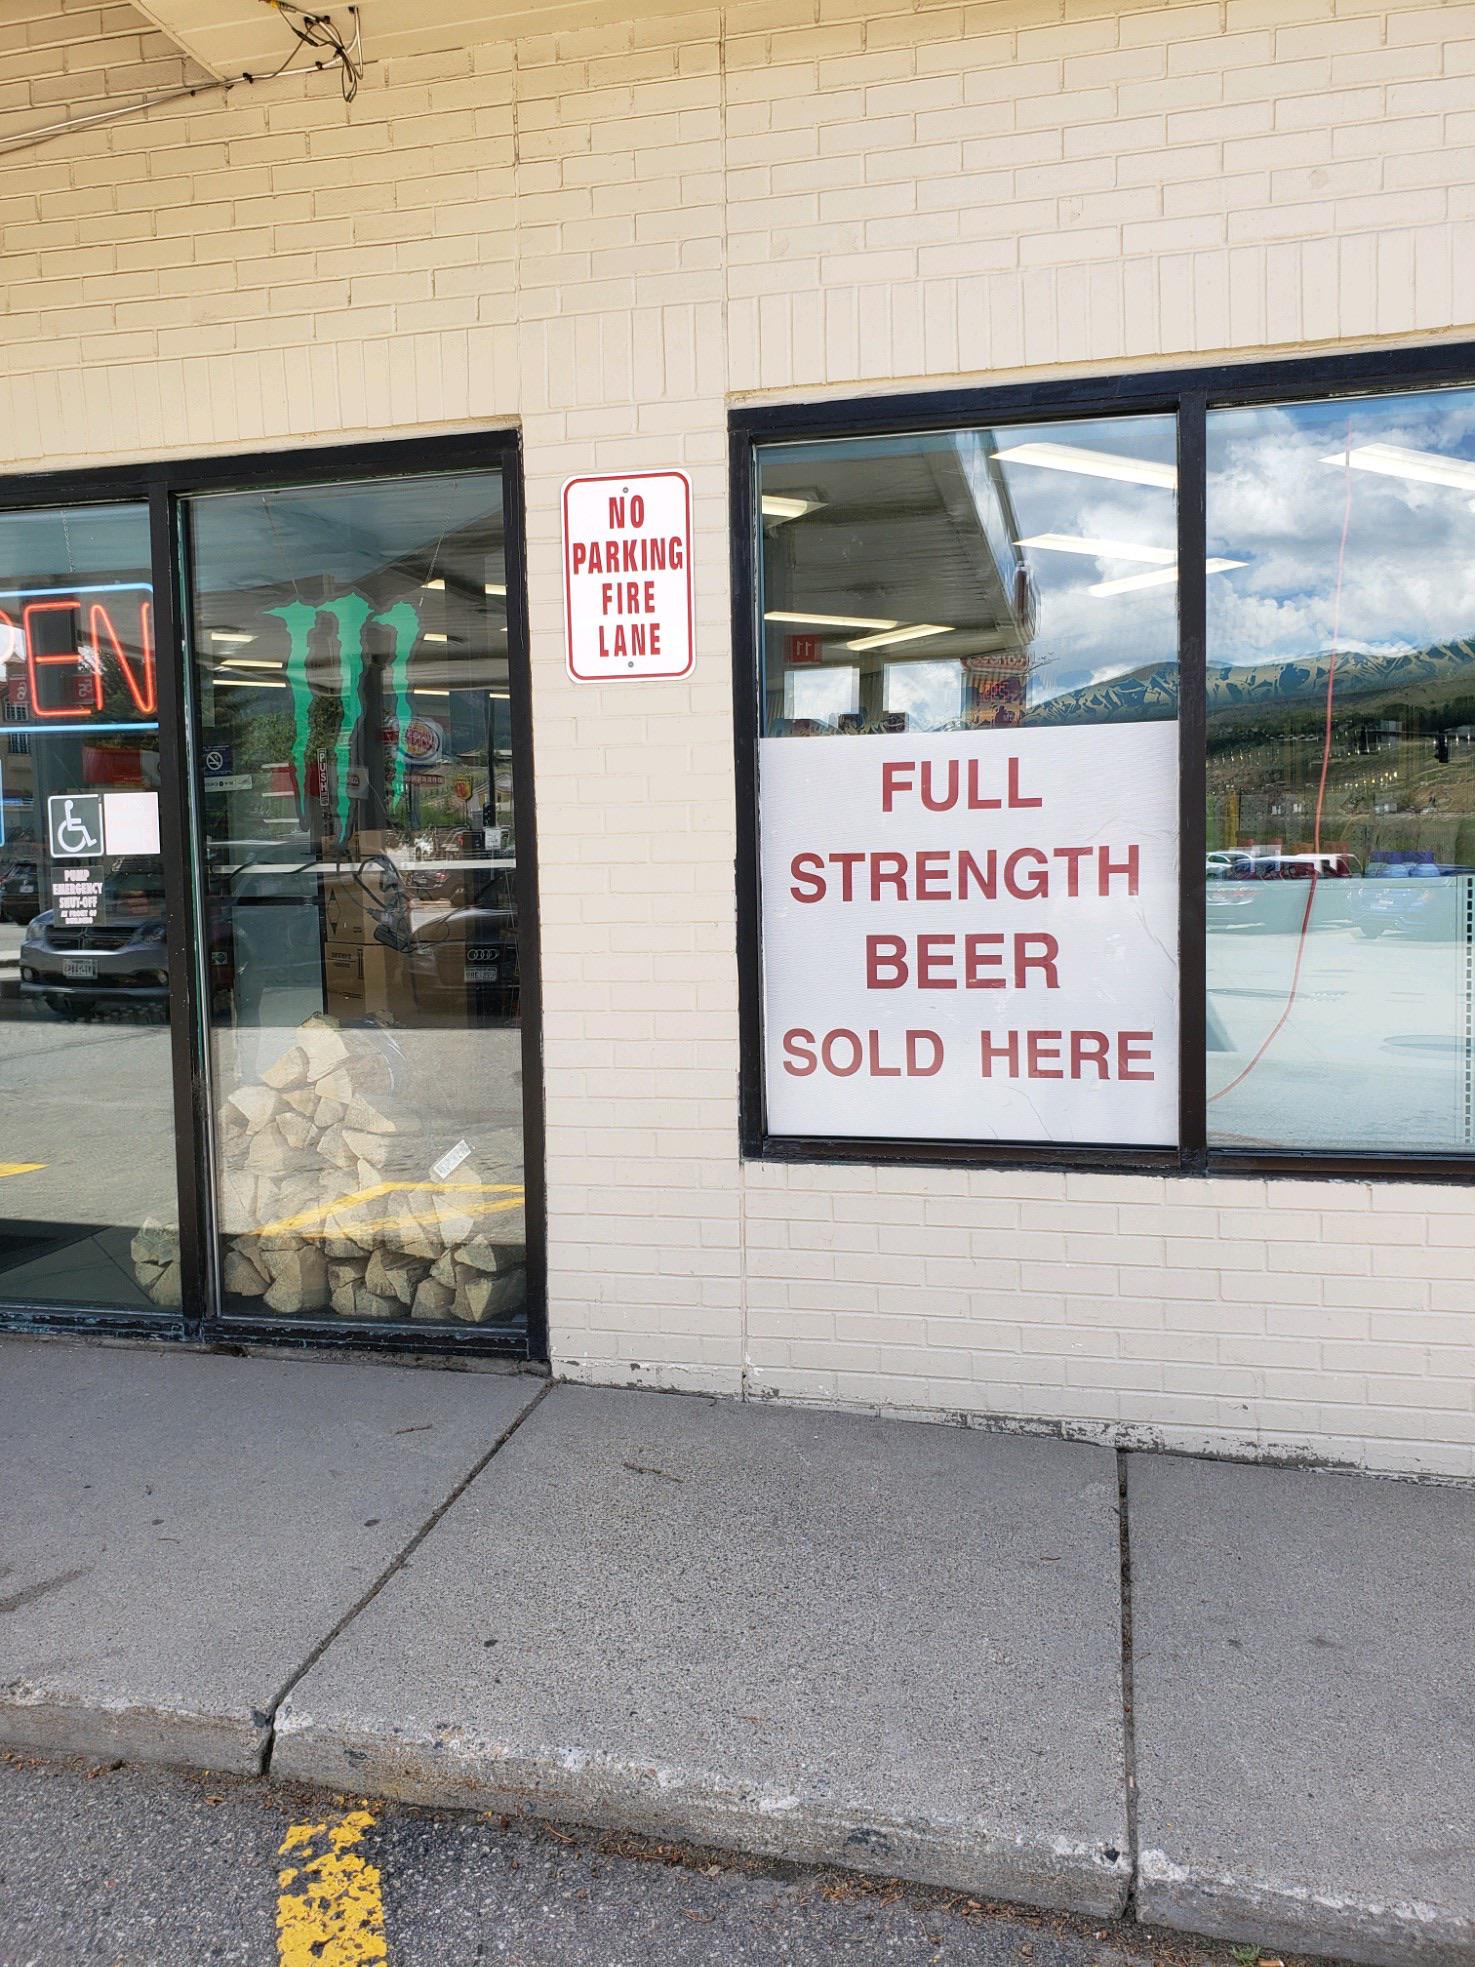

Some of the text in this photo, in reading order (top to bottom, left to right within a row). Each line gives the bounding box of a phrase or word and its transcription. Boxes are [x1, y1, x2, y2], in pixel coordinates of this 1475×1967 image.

[609, 494, 645, 530] NO
[572, 536, 684, 575] PARKING
[601, 580, 656, 616] FIRE
[598, 622, 661, 658] LANE
[319, 752, 328, 791] PUSH
[882, 757, 1043, 813] FULL
[52, 882, 103, 895] EMERGENCY
[64, 869, 90, 882] PUMP
[789, 844, 1140, 904] STRENGTH
[59, 896, 98, 909] SHUT-OFF
[865, 932, 1061, 989] BEER
[782, 1027, 1155, 1081] SOLD HERE
